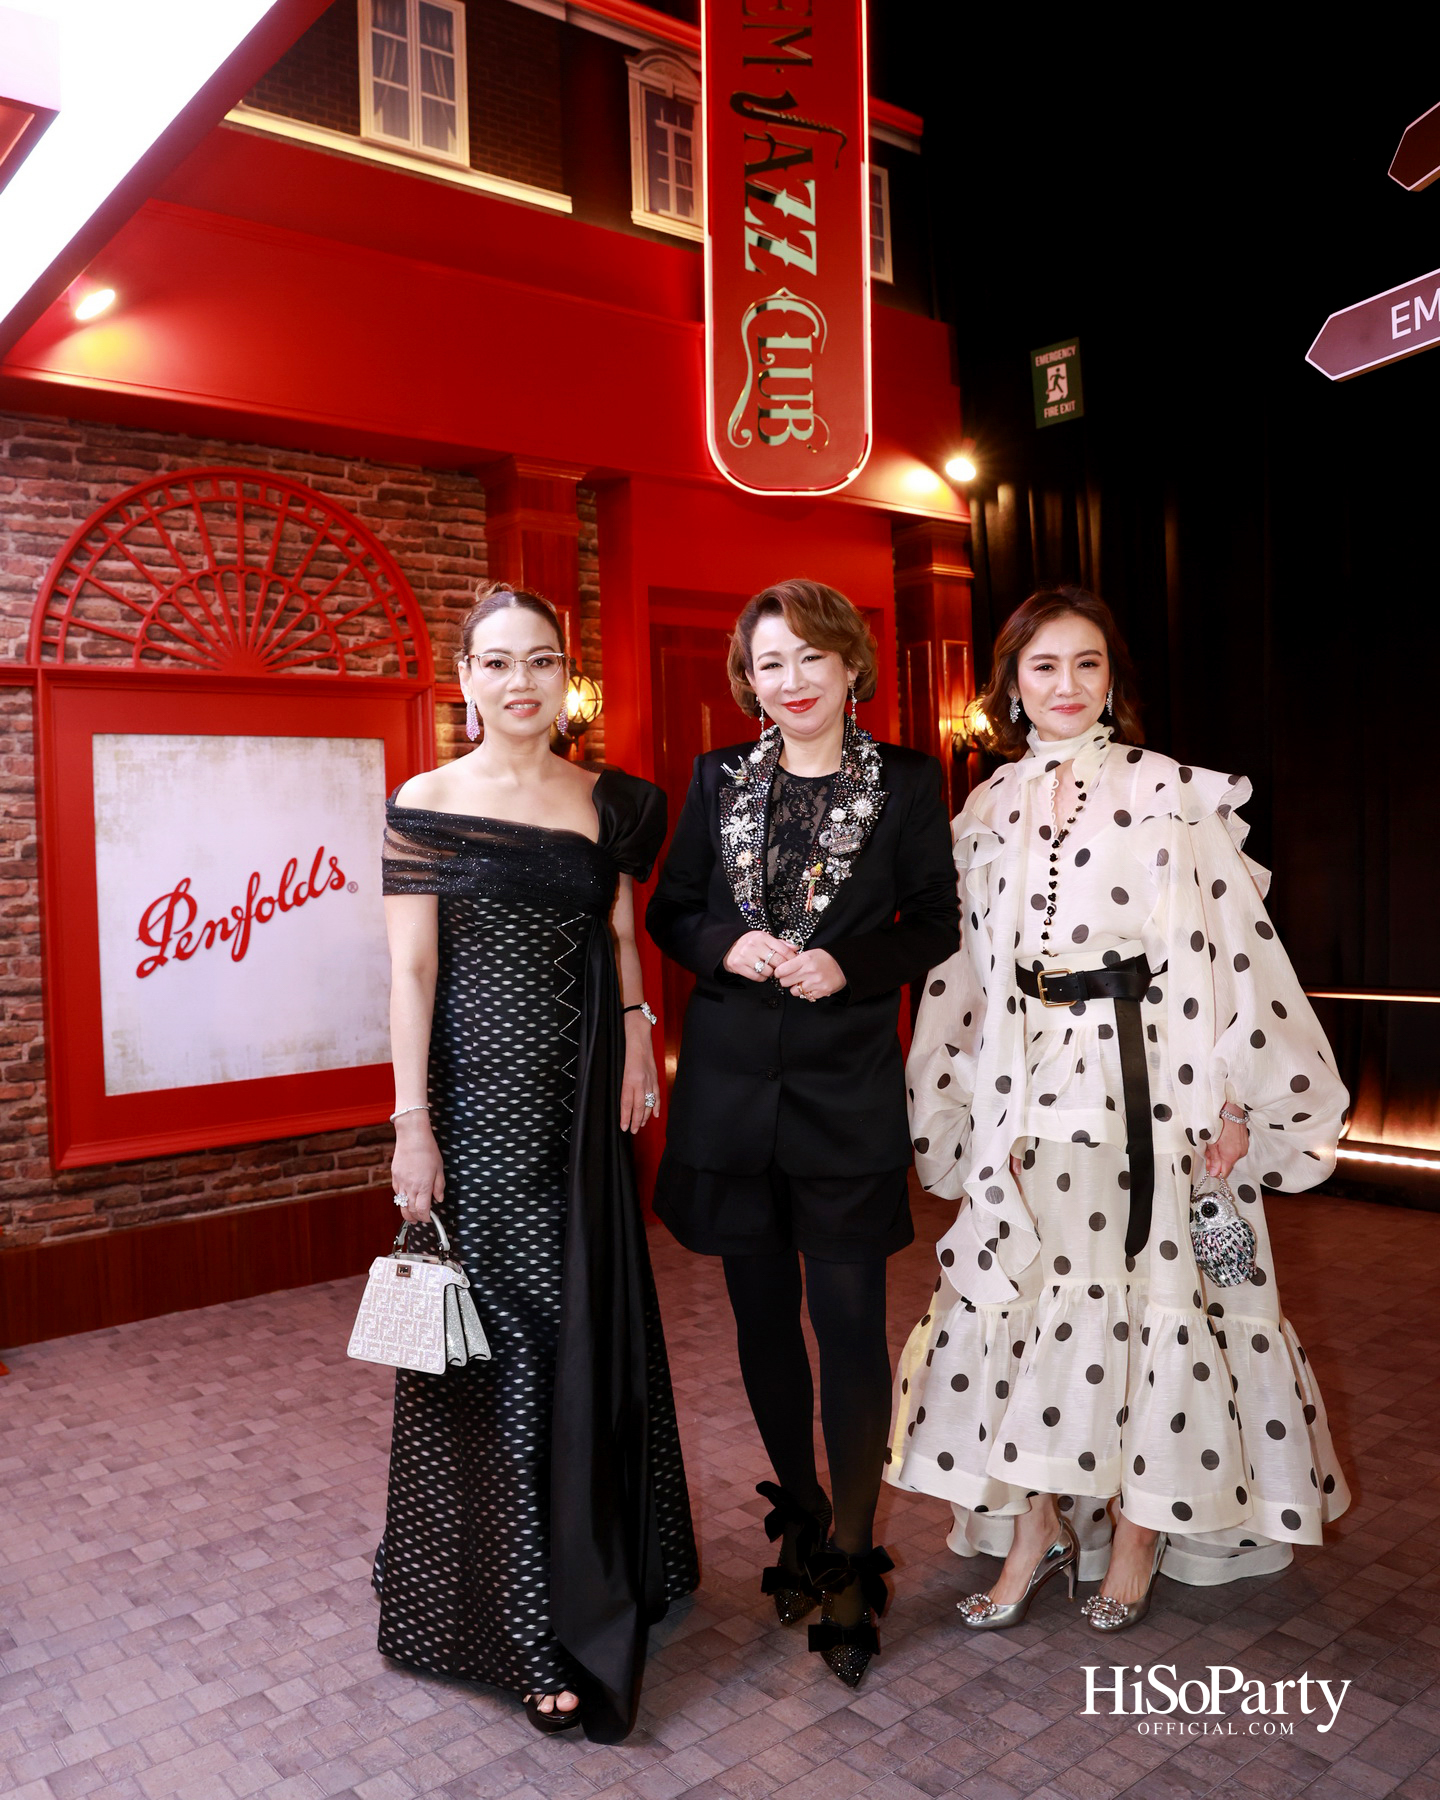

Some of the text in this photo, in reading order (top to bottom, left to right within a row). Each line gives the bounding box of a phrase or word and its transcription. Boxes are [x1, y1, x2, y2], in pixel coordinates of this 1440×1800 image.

[729, 88, 848, 276] JAZZ
[727, 287, 831, 454] CLUB
[1035, 345, 1076, 367] EMERGENCY
[1044, 400, 1075, 419] FIRE EXIT
